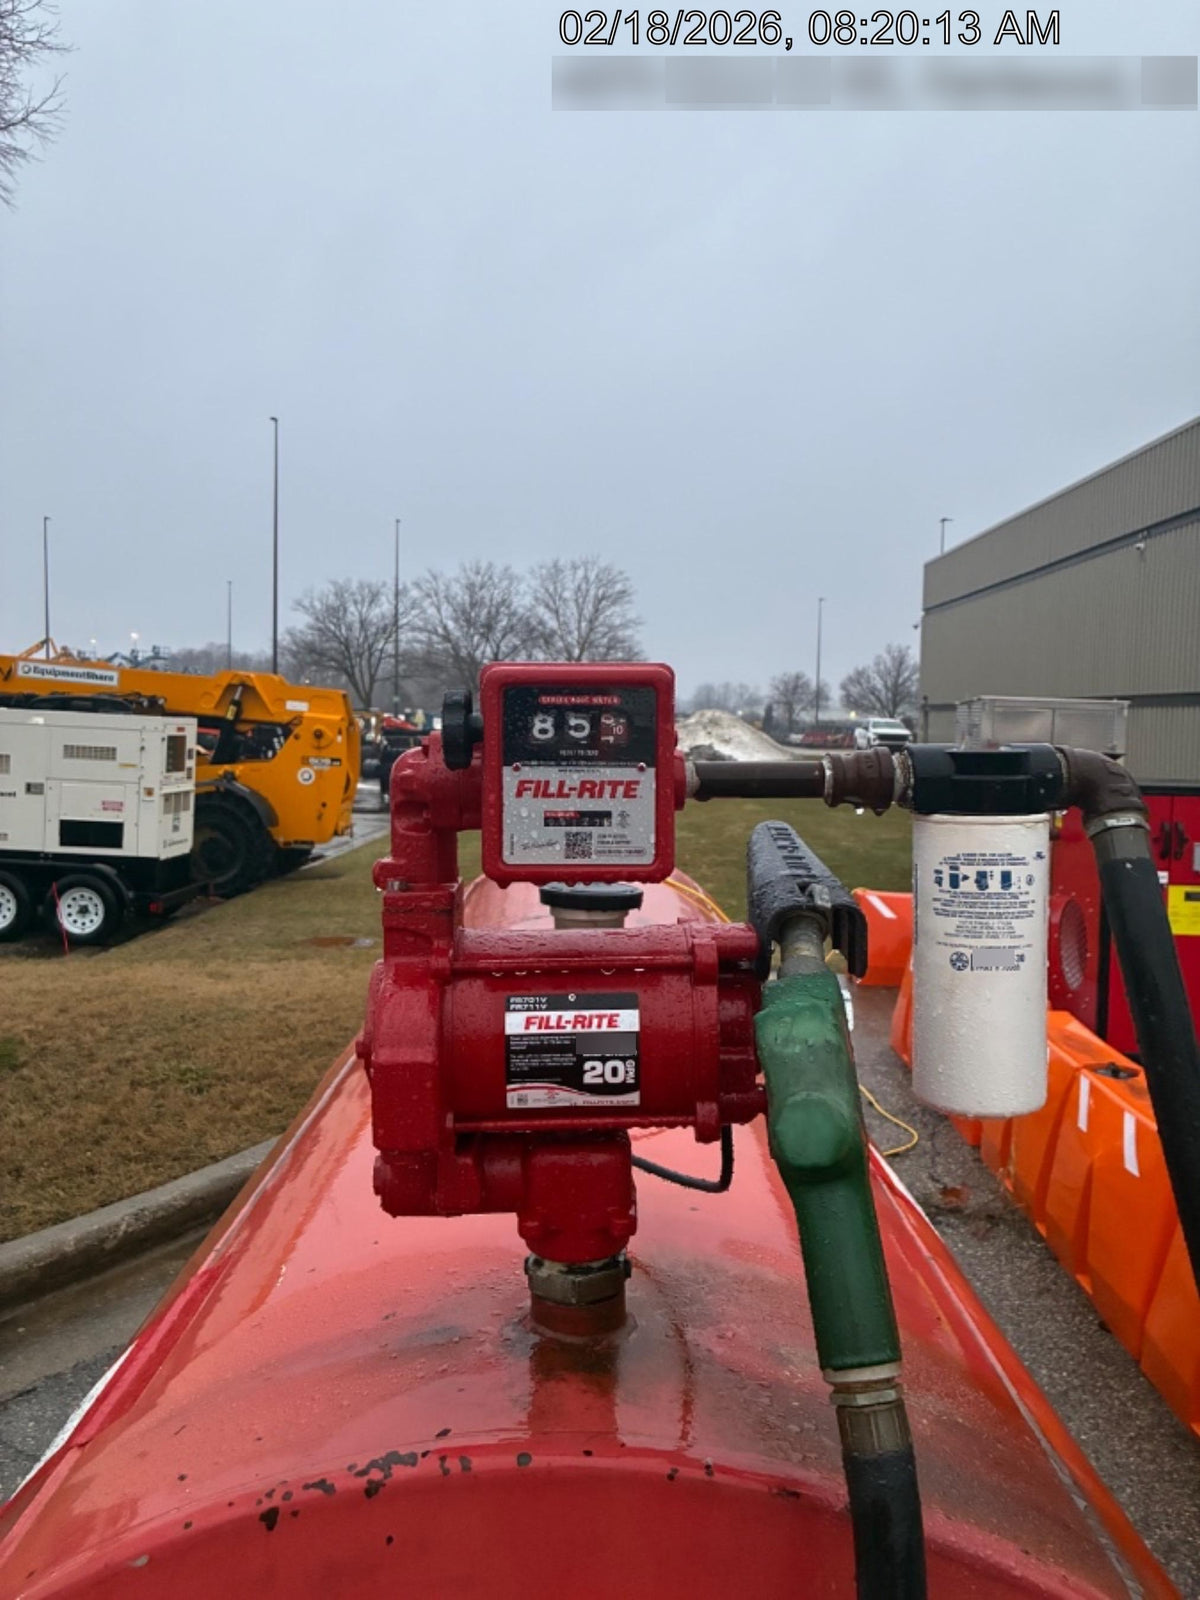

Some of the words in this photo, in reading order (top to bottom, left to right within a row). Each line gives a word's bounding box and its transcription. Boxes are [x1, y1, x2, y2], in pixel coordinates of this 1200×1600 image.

[33, 665, 115, 683] EquipmentShare
[515, 779, 641, 799] FILL-RITE
[524, 1013, 621, 1031] FILL-RITE
[582, 1060, 625, 1085] 20
